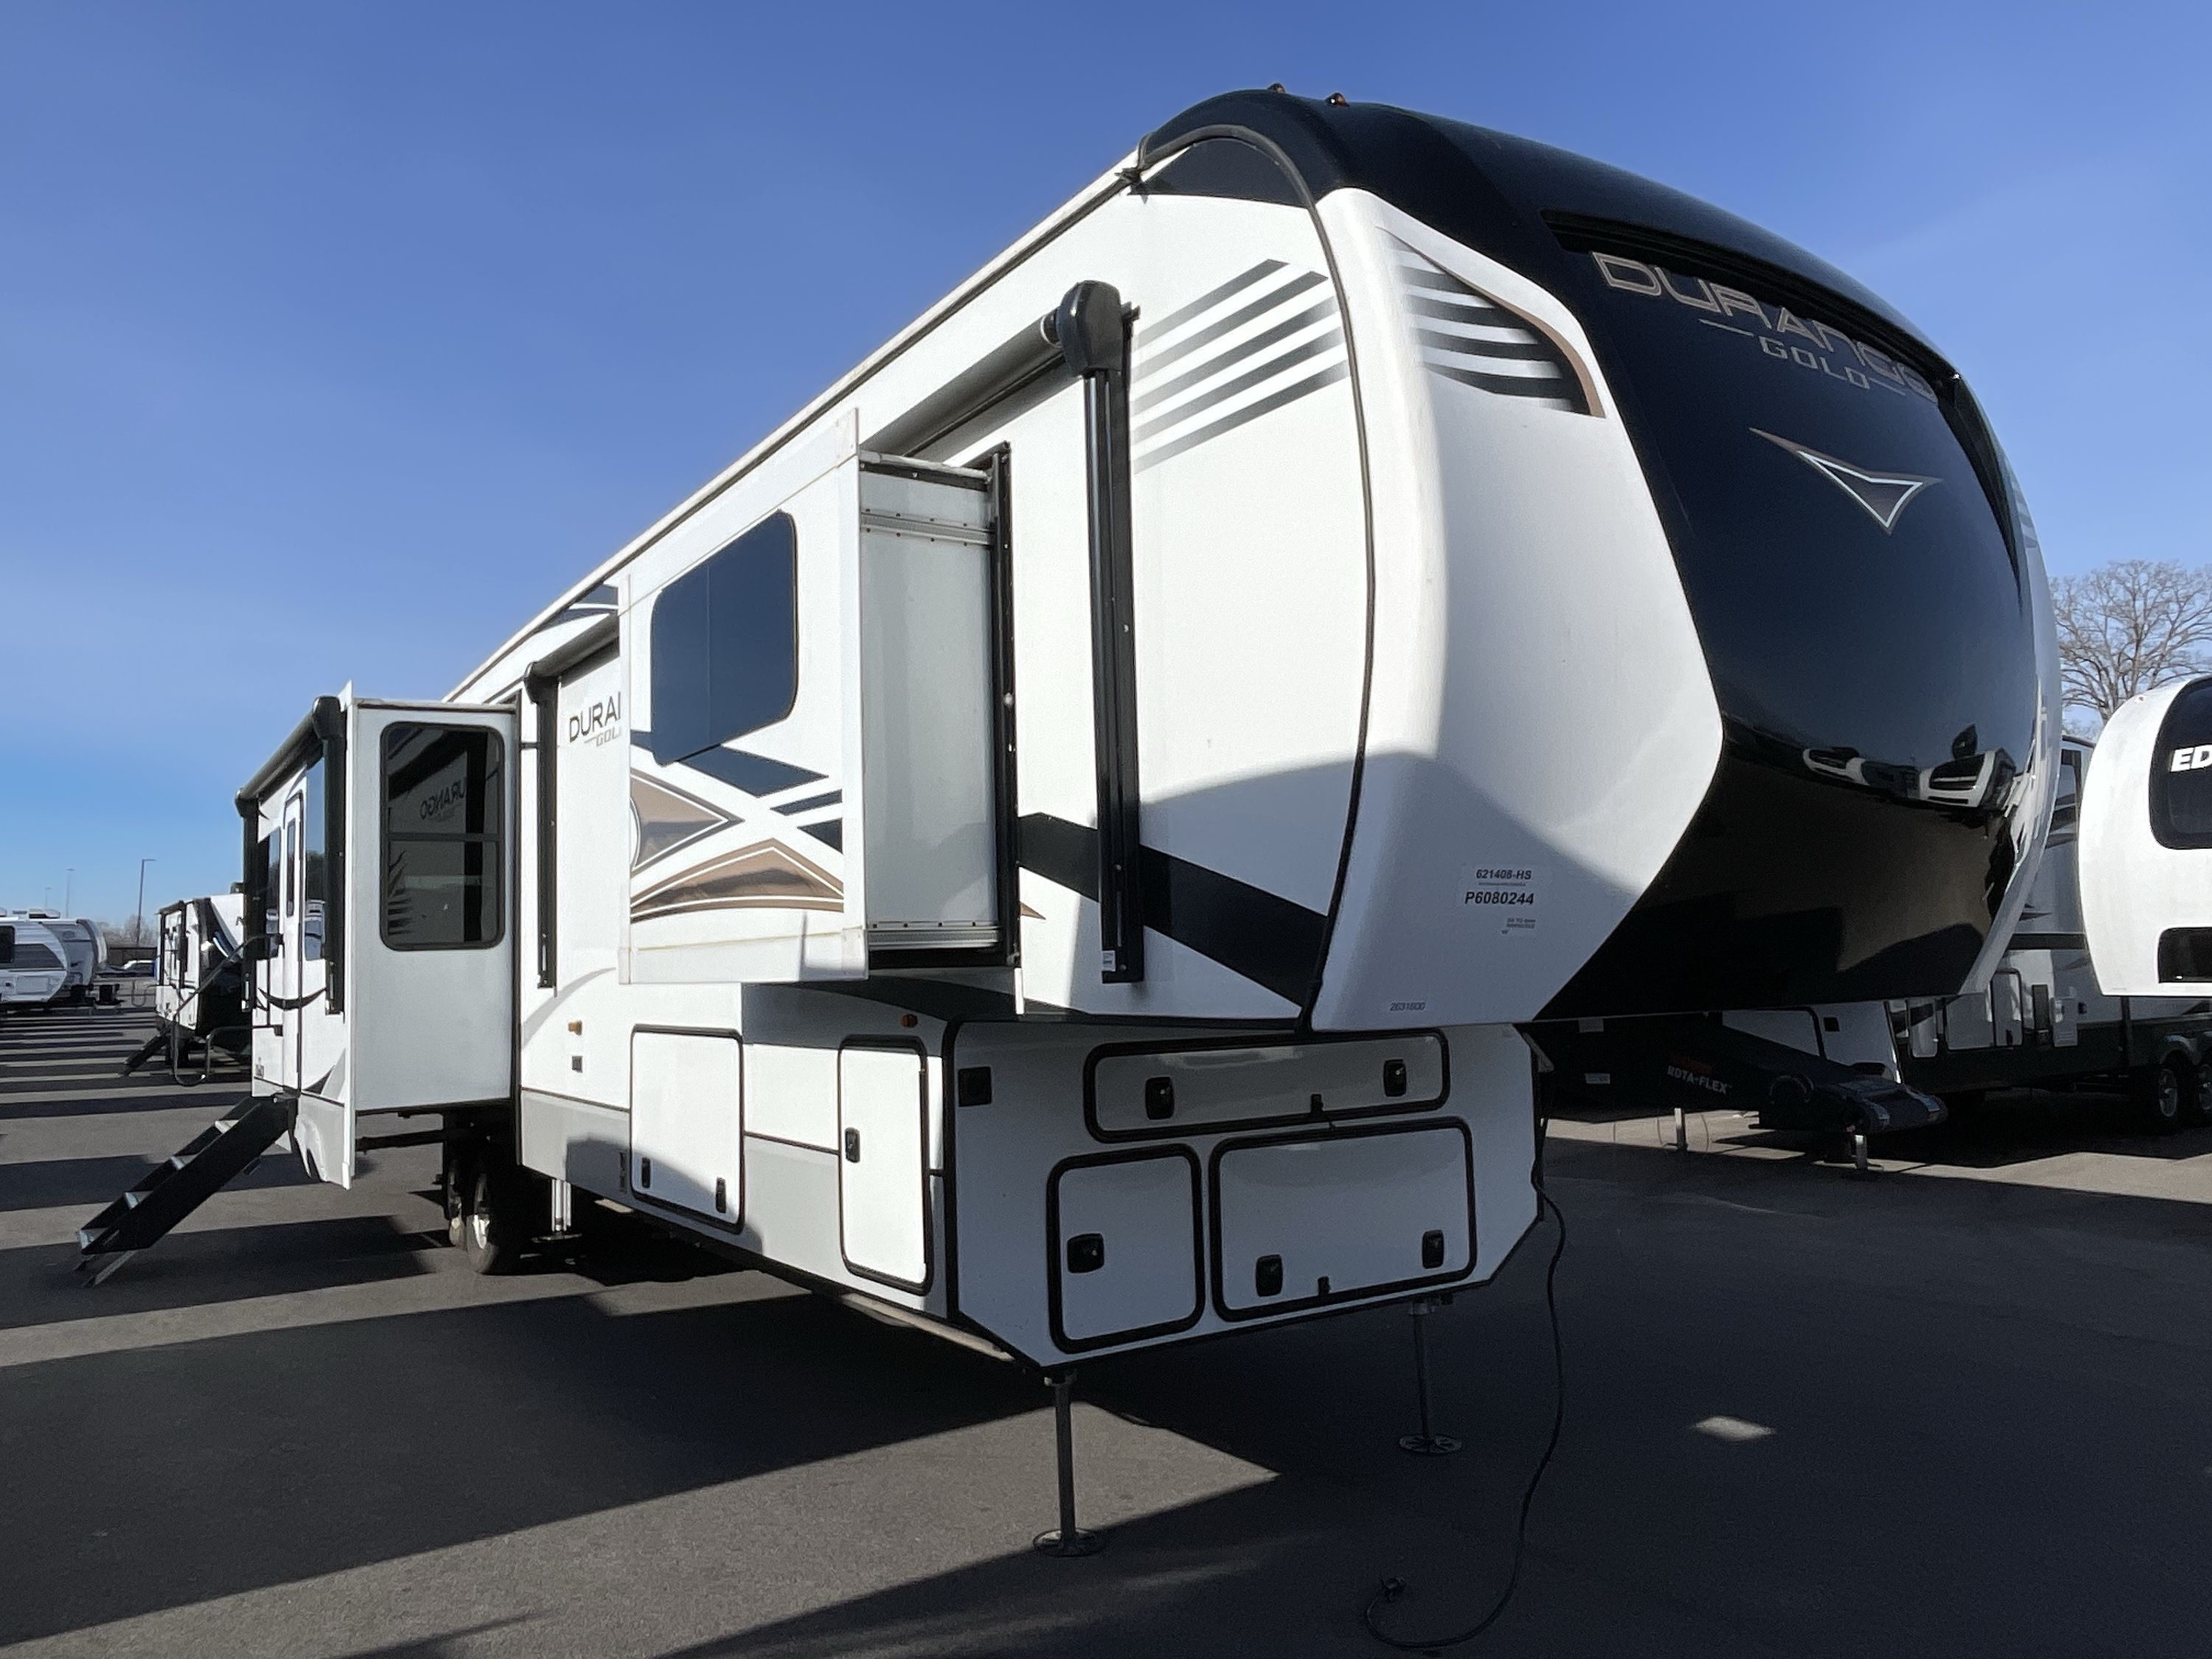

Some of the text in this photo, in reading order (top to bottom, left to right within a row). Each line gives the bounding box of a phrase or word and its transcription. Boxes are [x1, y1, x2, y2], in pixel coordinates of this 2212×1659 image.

[1592, 251, 1938, 403] DURANGO
[1760, 336, 1871, 389] GOLD
[570, 691, 621, 743] DURA
[596, 726, 621, 747] GOL
[1464, 891, 1534, 905] P6080244
[1667, 1065, 1727, 1094] ROTA-FLEX
